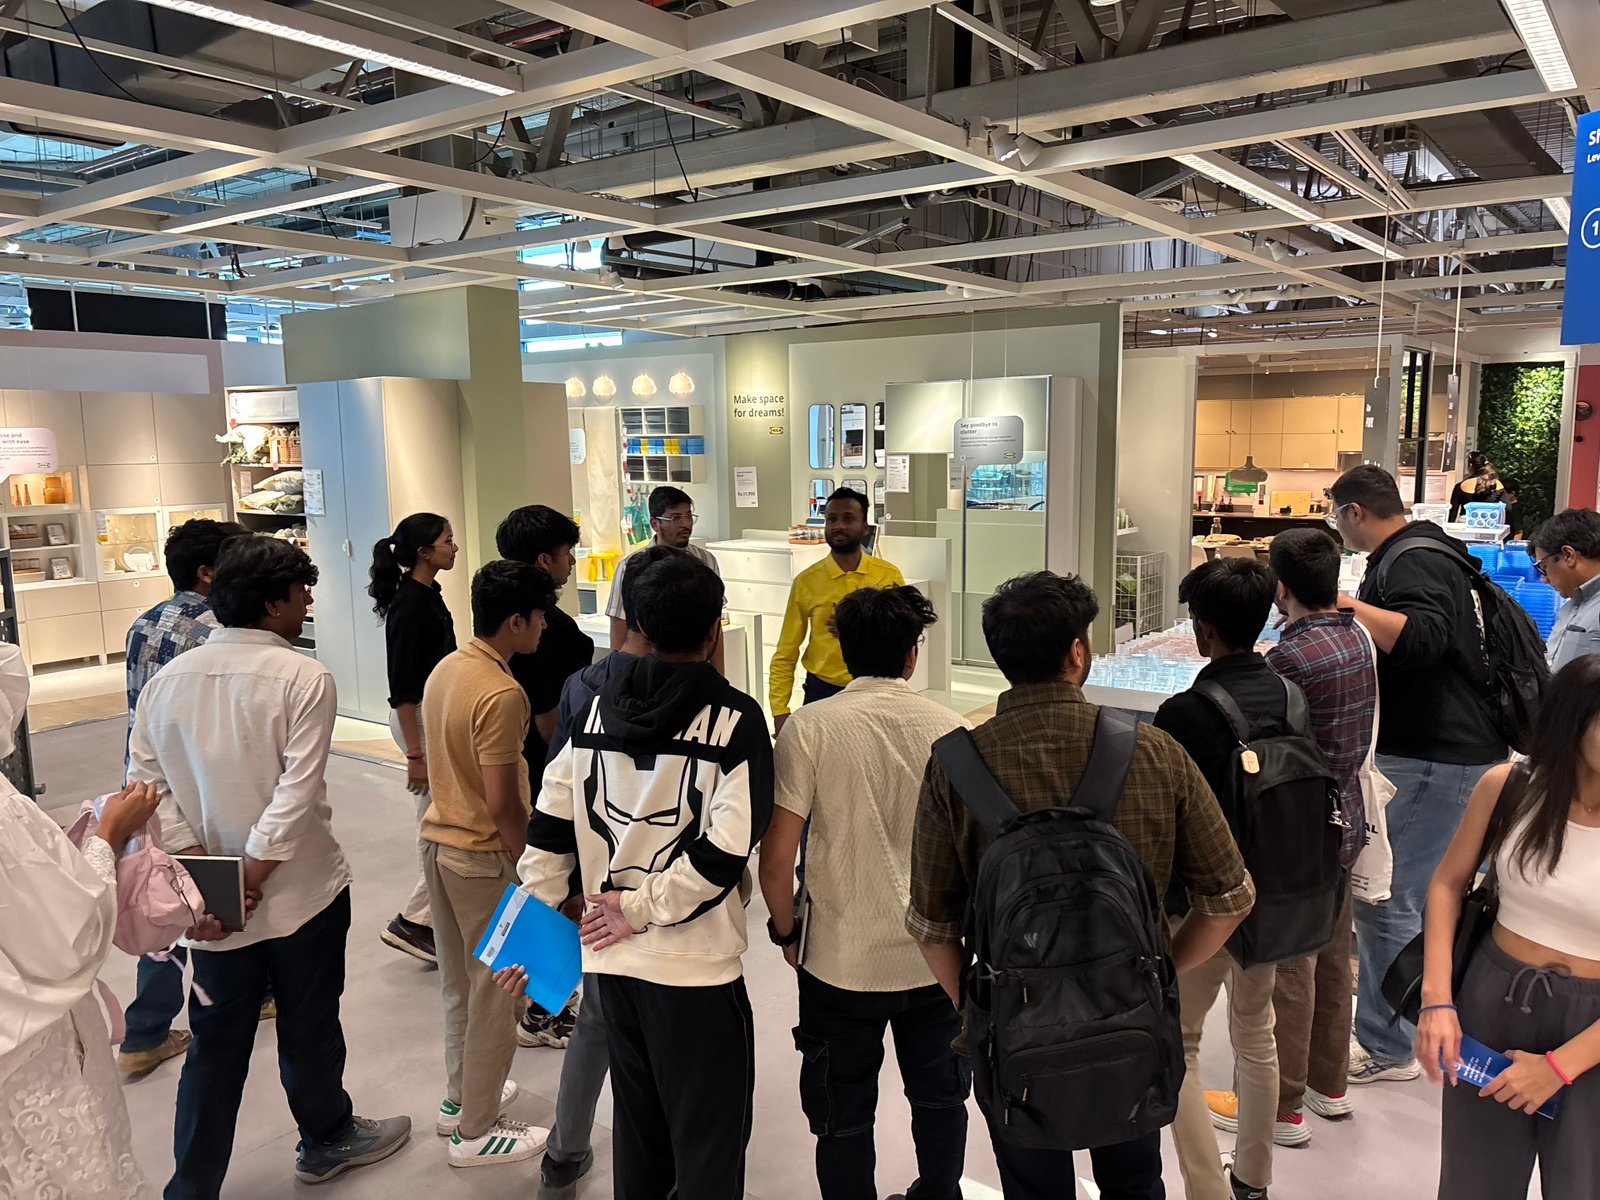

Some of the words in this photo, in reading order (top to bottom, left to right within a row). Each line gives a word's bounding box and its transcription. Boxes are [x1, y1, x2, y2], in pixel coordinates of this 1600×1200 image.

[733, 394, 757, 404] Make
[759, 395, 784, 406] space
[733, 408, 747, 418] for
[748, 407, 785, 418] dreams!
